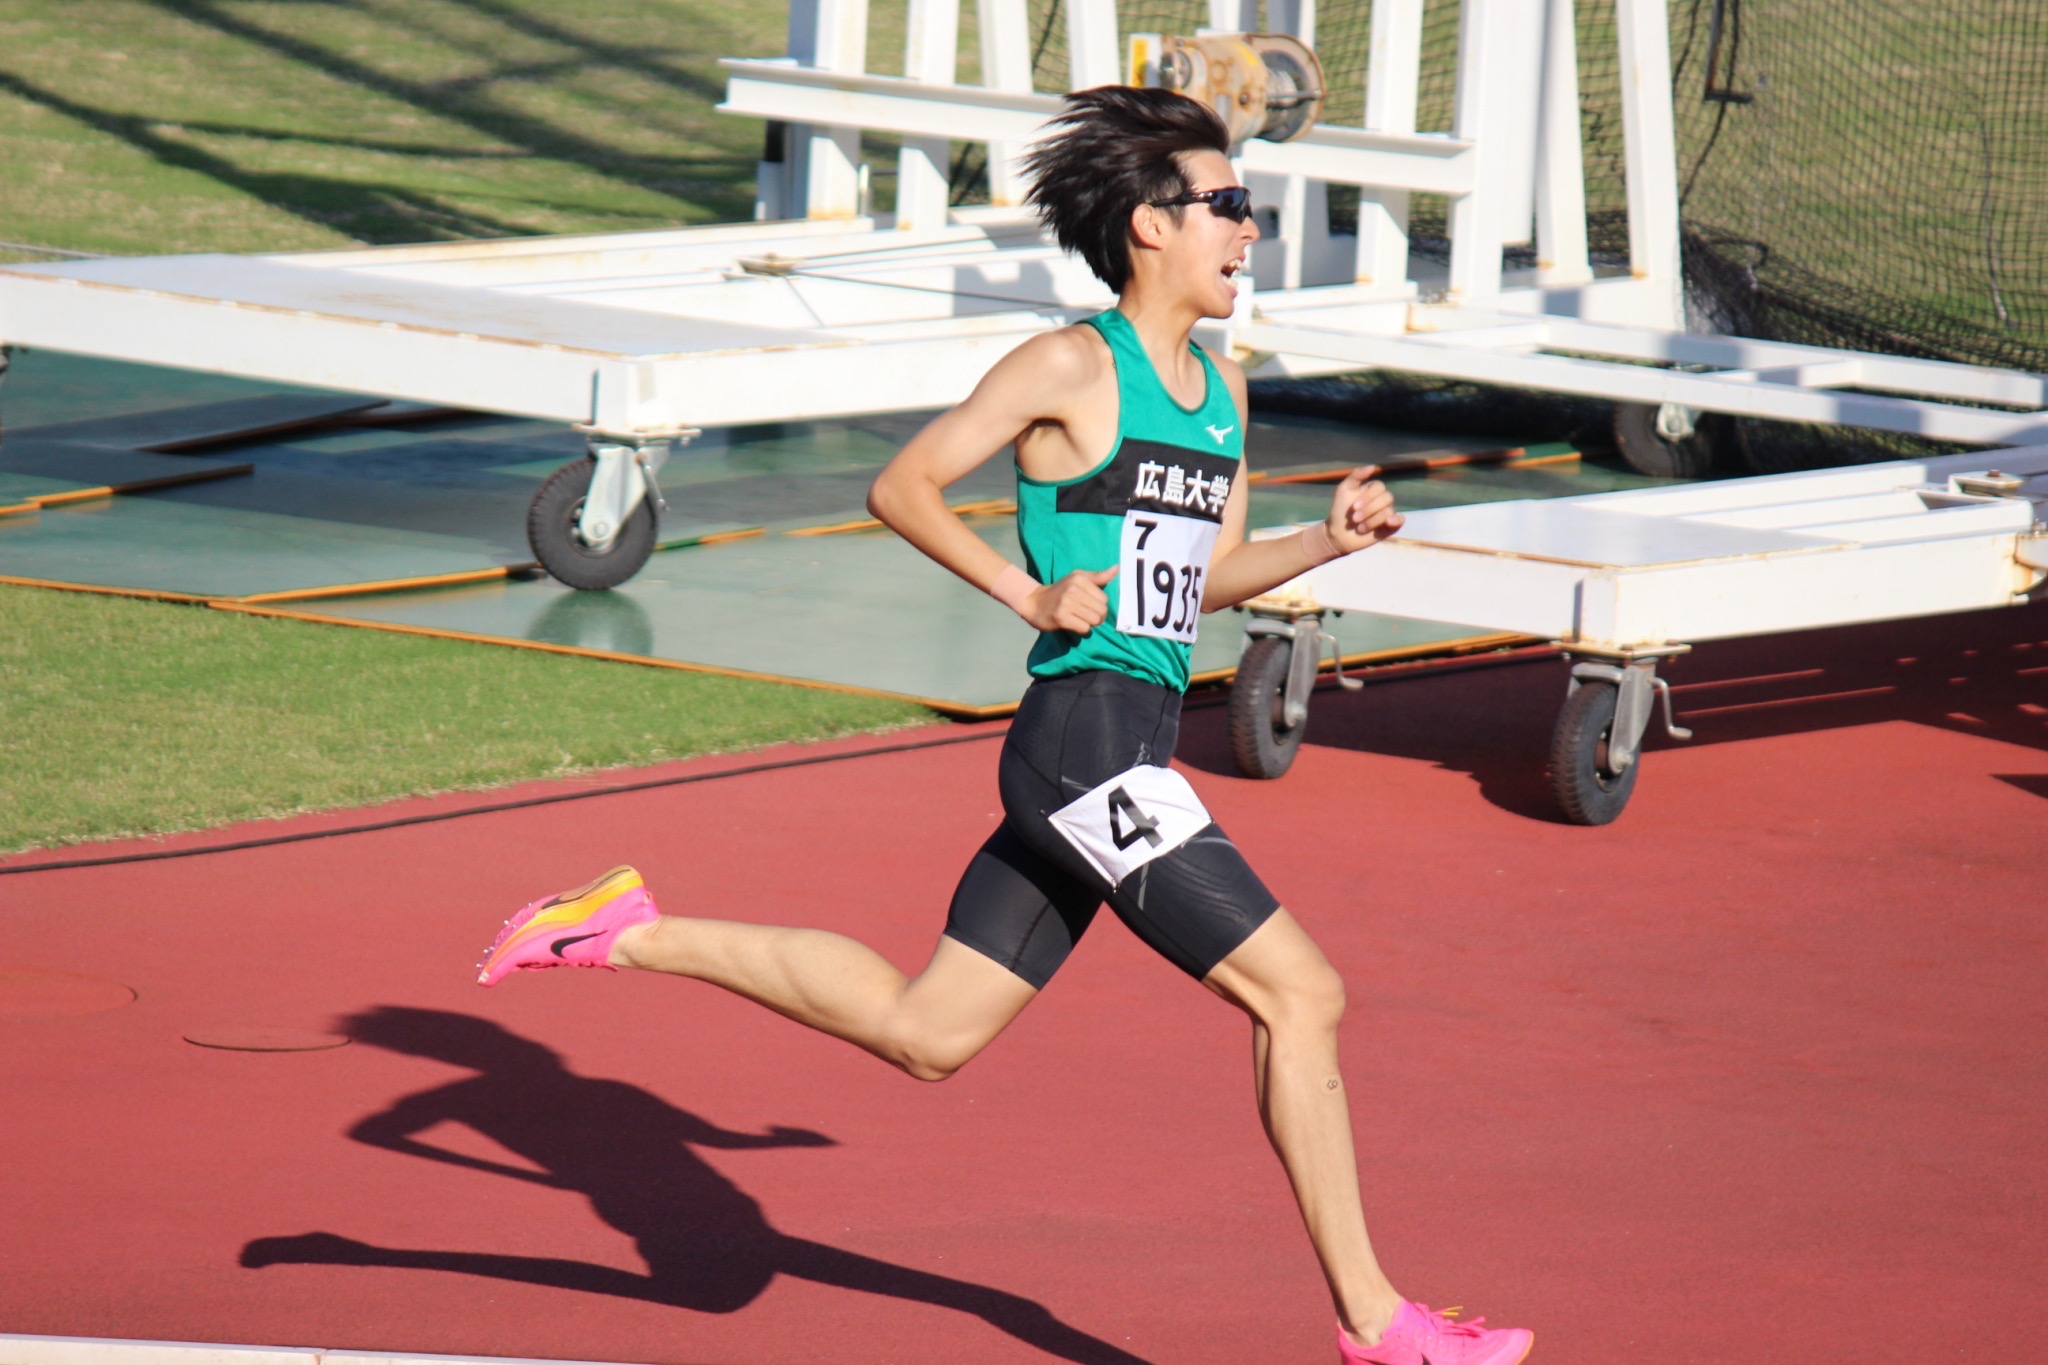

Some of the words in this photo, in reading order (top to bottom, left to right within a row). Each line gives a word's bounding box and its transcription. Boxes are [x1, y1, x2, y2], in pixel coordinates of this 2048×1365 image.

[1134, 460, 1229, 513] 広島大学
[1134, 519, 1158, 551] 7
[1136, 557, 1202, 634] 1935
[1108, 784, 1164, 852] 4
